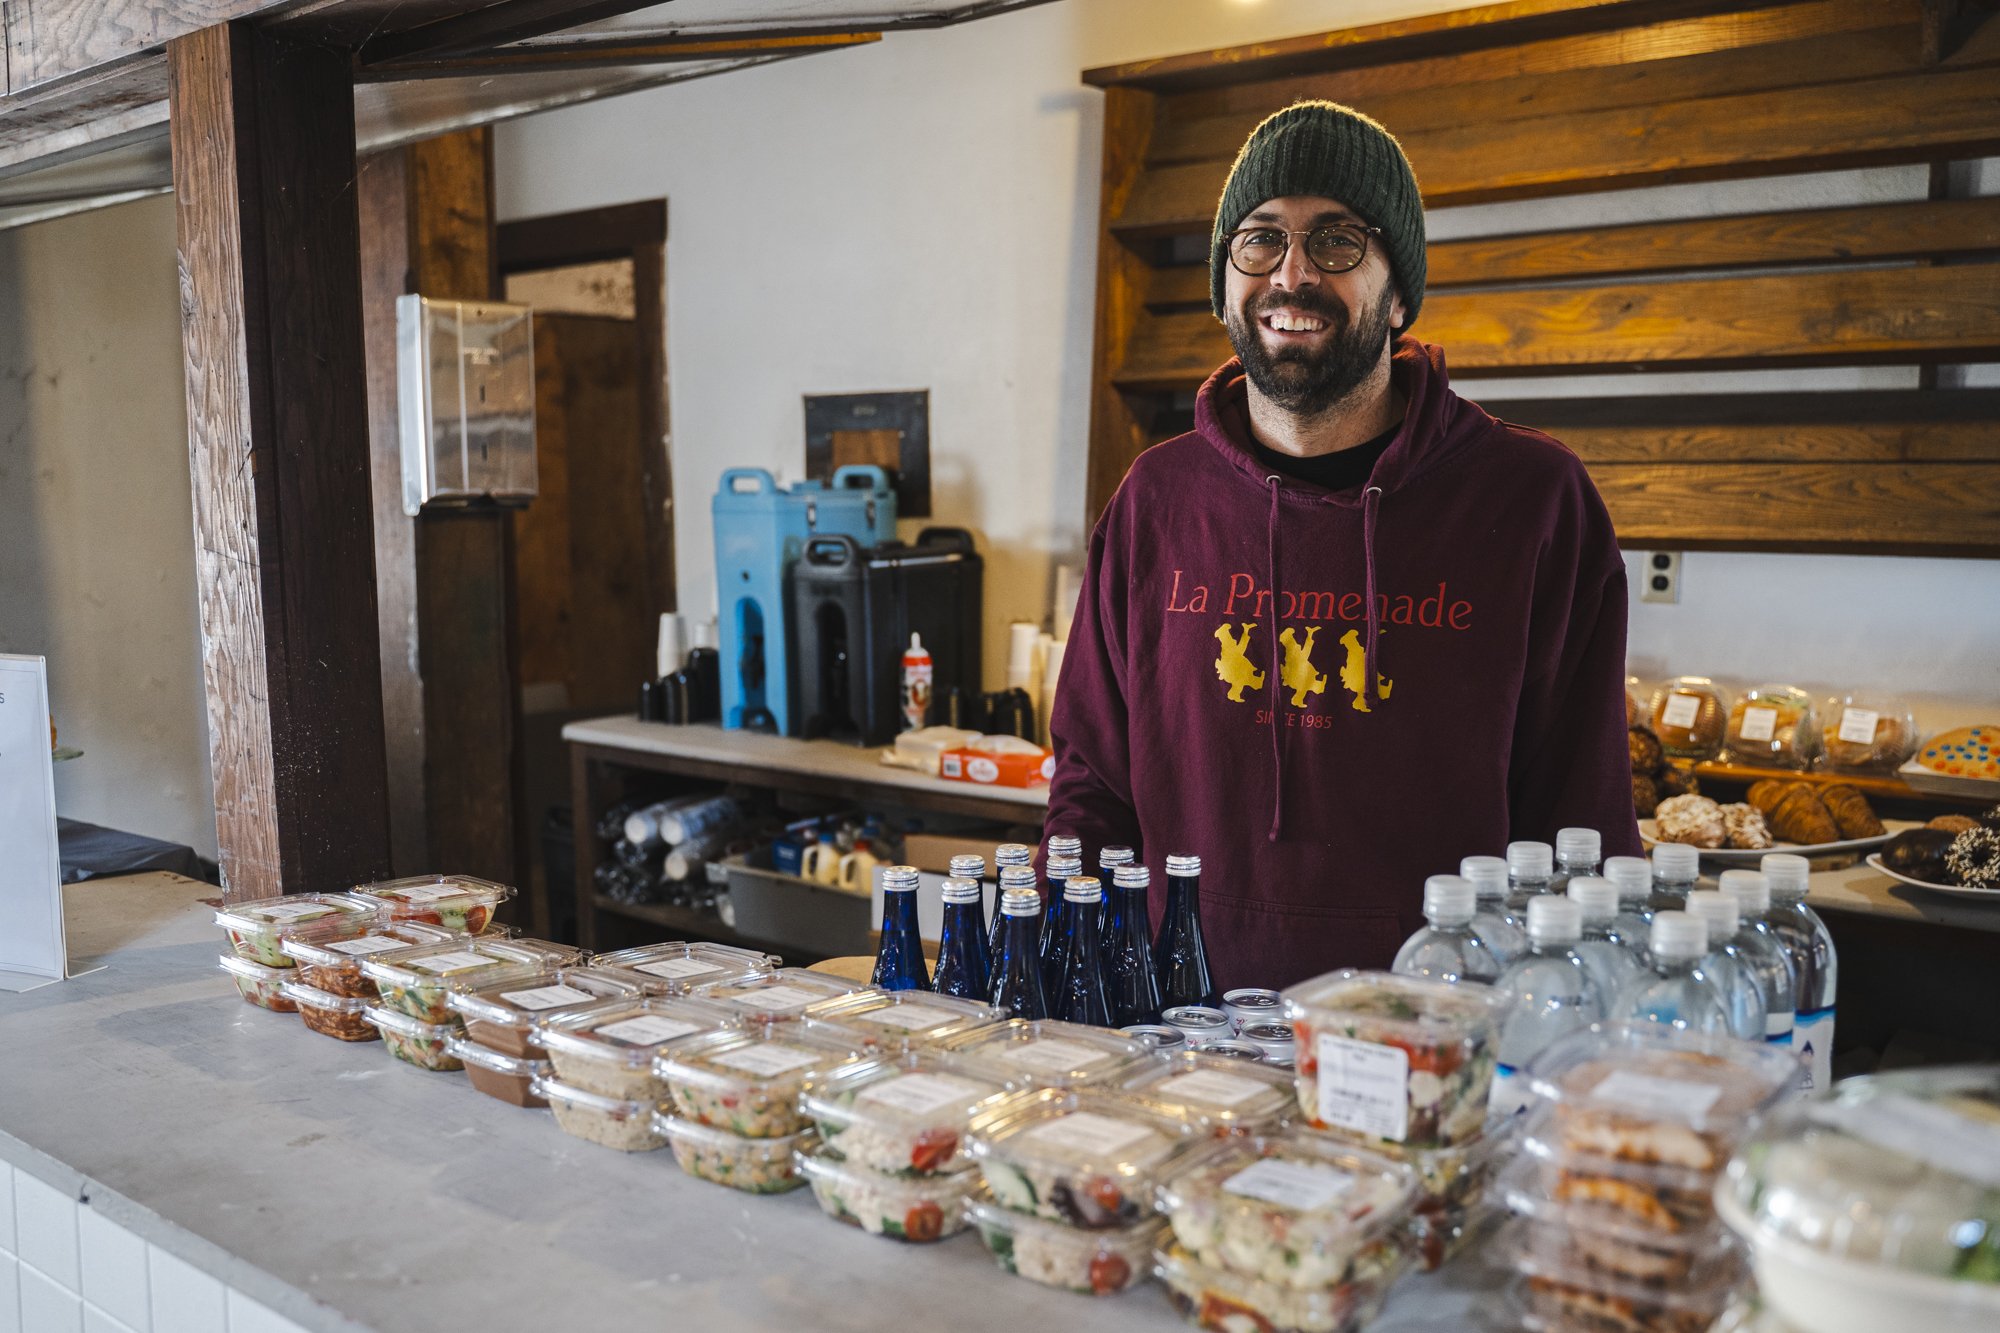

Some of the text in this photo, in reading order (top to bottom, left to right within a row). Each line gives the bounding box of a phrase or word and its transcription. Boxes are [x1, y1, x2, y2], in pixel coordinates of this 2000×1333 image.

[1166, 570, 1473, 631] La Promenade
[1255, 710, 1333, 729] SIE 1985
